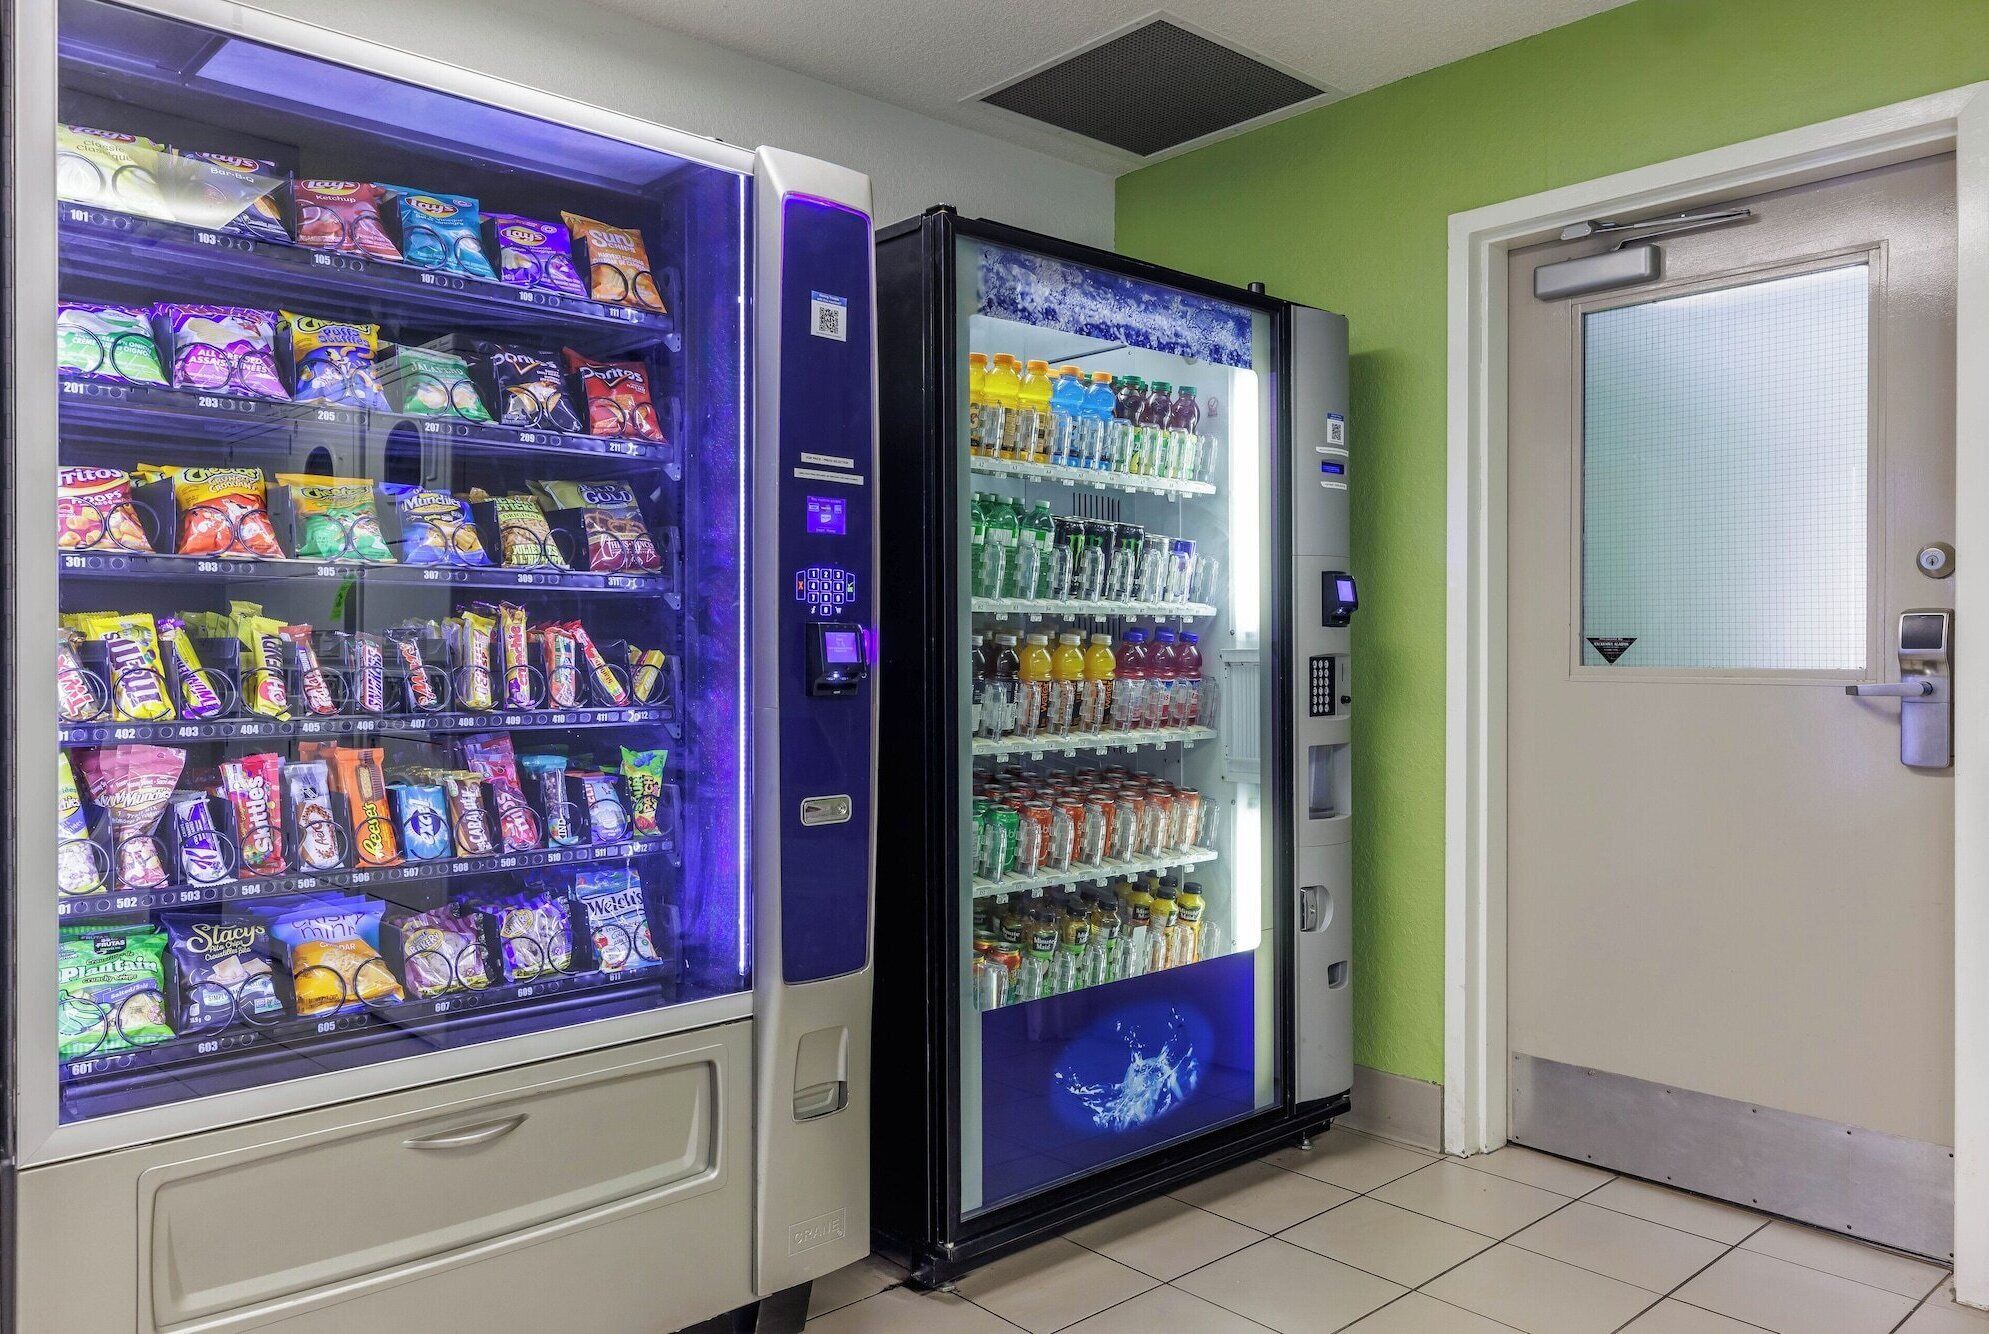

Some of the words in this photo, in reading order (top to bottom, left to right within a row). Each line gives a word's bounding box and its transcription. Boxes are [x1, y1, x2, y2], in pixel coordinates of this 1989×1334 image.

[315, 194, 356, 204] Ketchup
[70, 210, 89, 222] 101
[198, 232, 217, 244] 103
[314, 254, 331, 266] 105
[420, 273, 435, 284] 107
[518, 291, 533, 302] 109
[579, 366, 644, 382] Doritos
[64, 382, 84, 395] 201
[198, 397, 218, 408] 203
[318, 410, 336, 422] 205
[424, 422, 440, 432] 207
[520, 432, 535, 443] 209
[609, 442, 621, 452] 211
[585, 490, 633, 504] GOLD
[403, 494, 462, 512] Munchies
[66, 556, 86, 568] 301
[198, 561, 218, 572] 303
[318, 566, 336, 577] 305
[424, 570, 438, 580] 307
[518, 574, 533, 584] 309
[368, 650, 383, 711] SNICKERS
[458, 716, 474, 727] 408
[506, 716, 521, 726] 409
[552, 714, 566, 724] 410
[596, 712, 608, 722] 411
[302, 722, 320, 732] 405
[356, 720, 374, 730] 406
[410, 718, 426, 728] 407
[114, 728, 136, 740] 402
[178, 726, 199, 738] 403
[240, 724, 259, 736] 404
[58, 730, 70, 742] 01
[246, 775, 274, 852] Skittles
[362, 801, 384, 858] Reese's
[548, 852, 562, 862] 510
[594, 847, 606, 857] 511
[452, 862, 469, 872] 508
[500, 858, 516, 868] 509
[352, 872, 370, 882] 506
[404, 867, 419, 877] 507
[298, 878, 316, 888] 505
[242, 884, 260, 896] 504
[180, 890, 200, 902] 503
[116, 897, 138, 908] 502
[586, 890, 644, 916] Welch's
[410, 932, 440, 954] BAKERY
[60, 956, 158, 984] Plantain
[518, 986, 533, 998] 609
[434, 1001, 450, 1012] 607
[317, 1021, 336, 1032] 605
[198, 1041, 218, 1054] 603
[72, 1062, 93, 1076] 601
